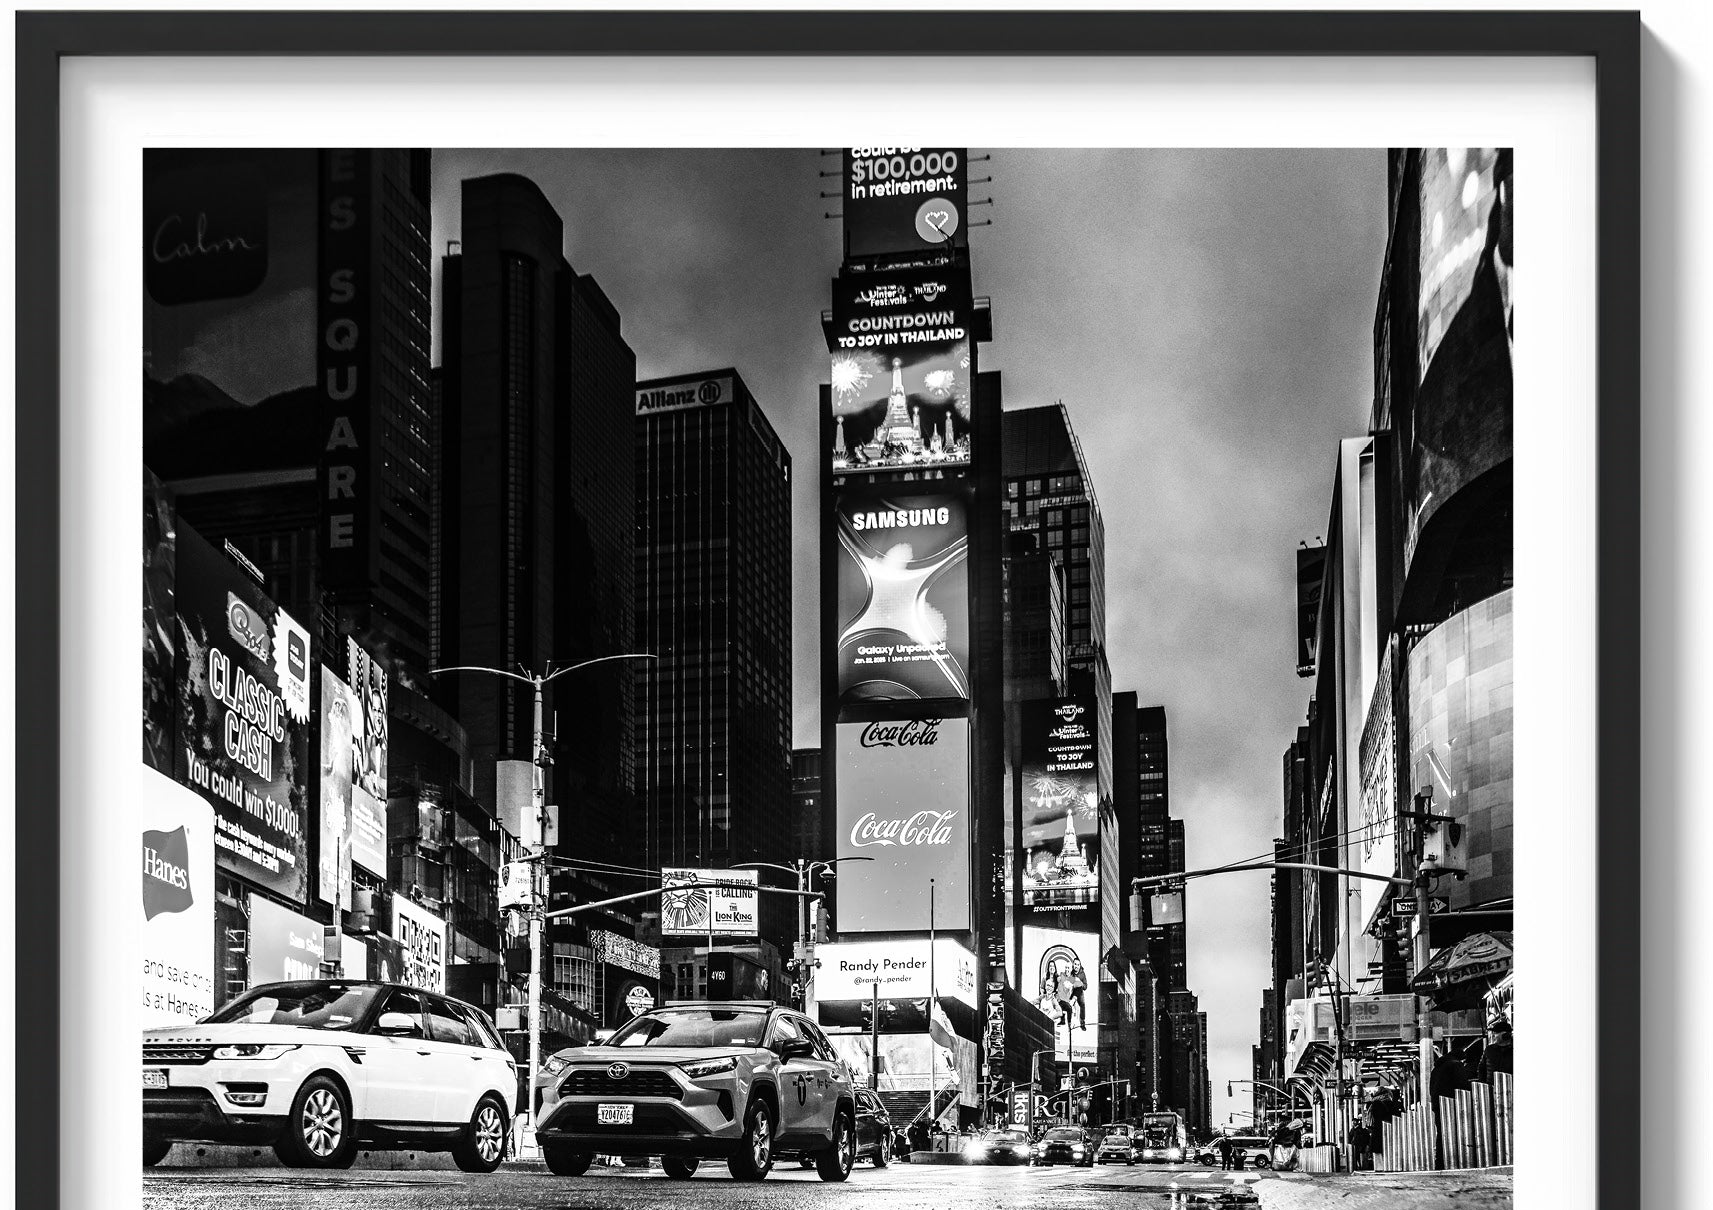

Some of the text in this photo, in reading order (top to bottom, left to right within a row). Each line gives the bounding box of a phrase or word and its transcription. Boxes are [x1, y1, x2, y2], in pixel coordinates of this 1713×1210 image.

[851, 151, 958, 184] $100,000
[851, 175, 958, 199] in retirement.
[152, 211, 264, 263] Calm
[848, 310, 955, 333] COUNTDOWN
[838, 327, 965, 348] TO JOY IN THAILAND
[638, 389, 696, 410] Allianz
[852, 507, 949, 531] SAMSUNG
[857, 646, 895, 656] Galaxy
[209, 648, 285, 743] CLASSIC
[225, 710, 272, 782] CASH
[1048, 744, 1092, 752] COUNTDOWN
[1056, 762, 1094, 770] THAILAND
[186, 748, 210, 789] You
[211, 771, 243, 808] could
[245, 789, 264, 820] win
[265, 795, 299, 839] $1,000!
[144, 846, 188, 889] Hanes
[721, 887, 753, 898] CALLING
[711, 971, 726, 981] 4Y60
[840, 957, 927, 972] Randy Pender
[854, 975, 912, 985] @randy_pender
[1014, 1092, 1029, 1124] tkts
